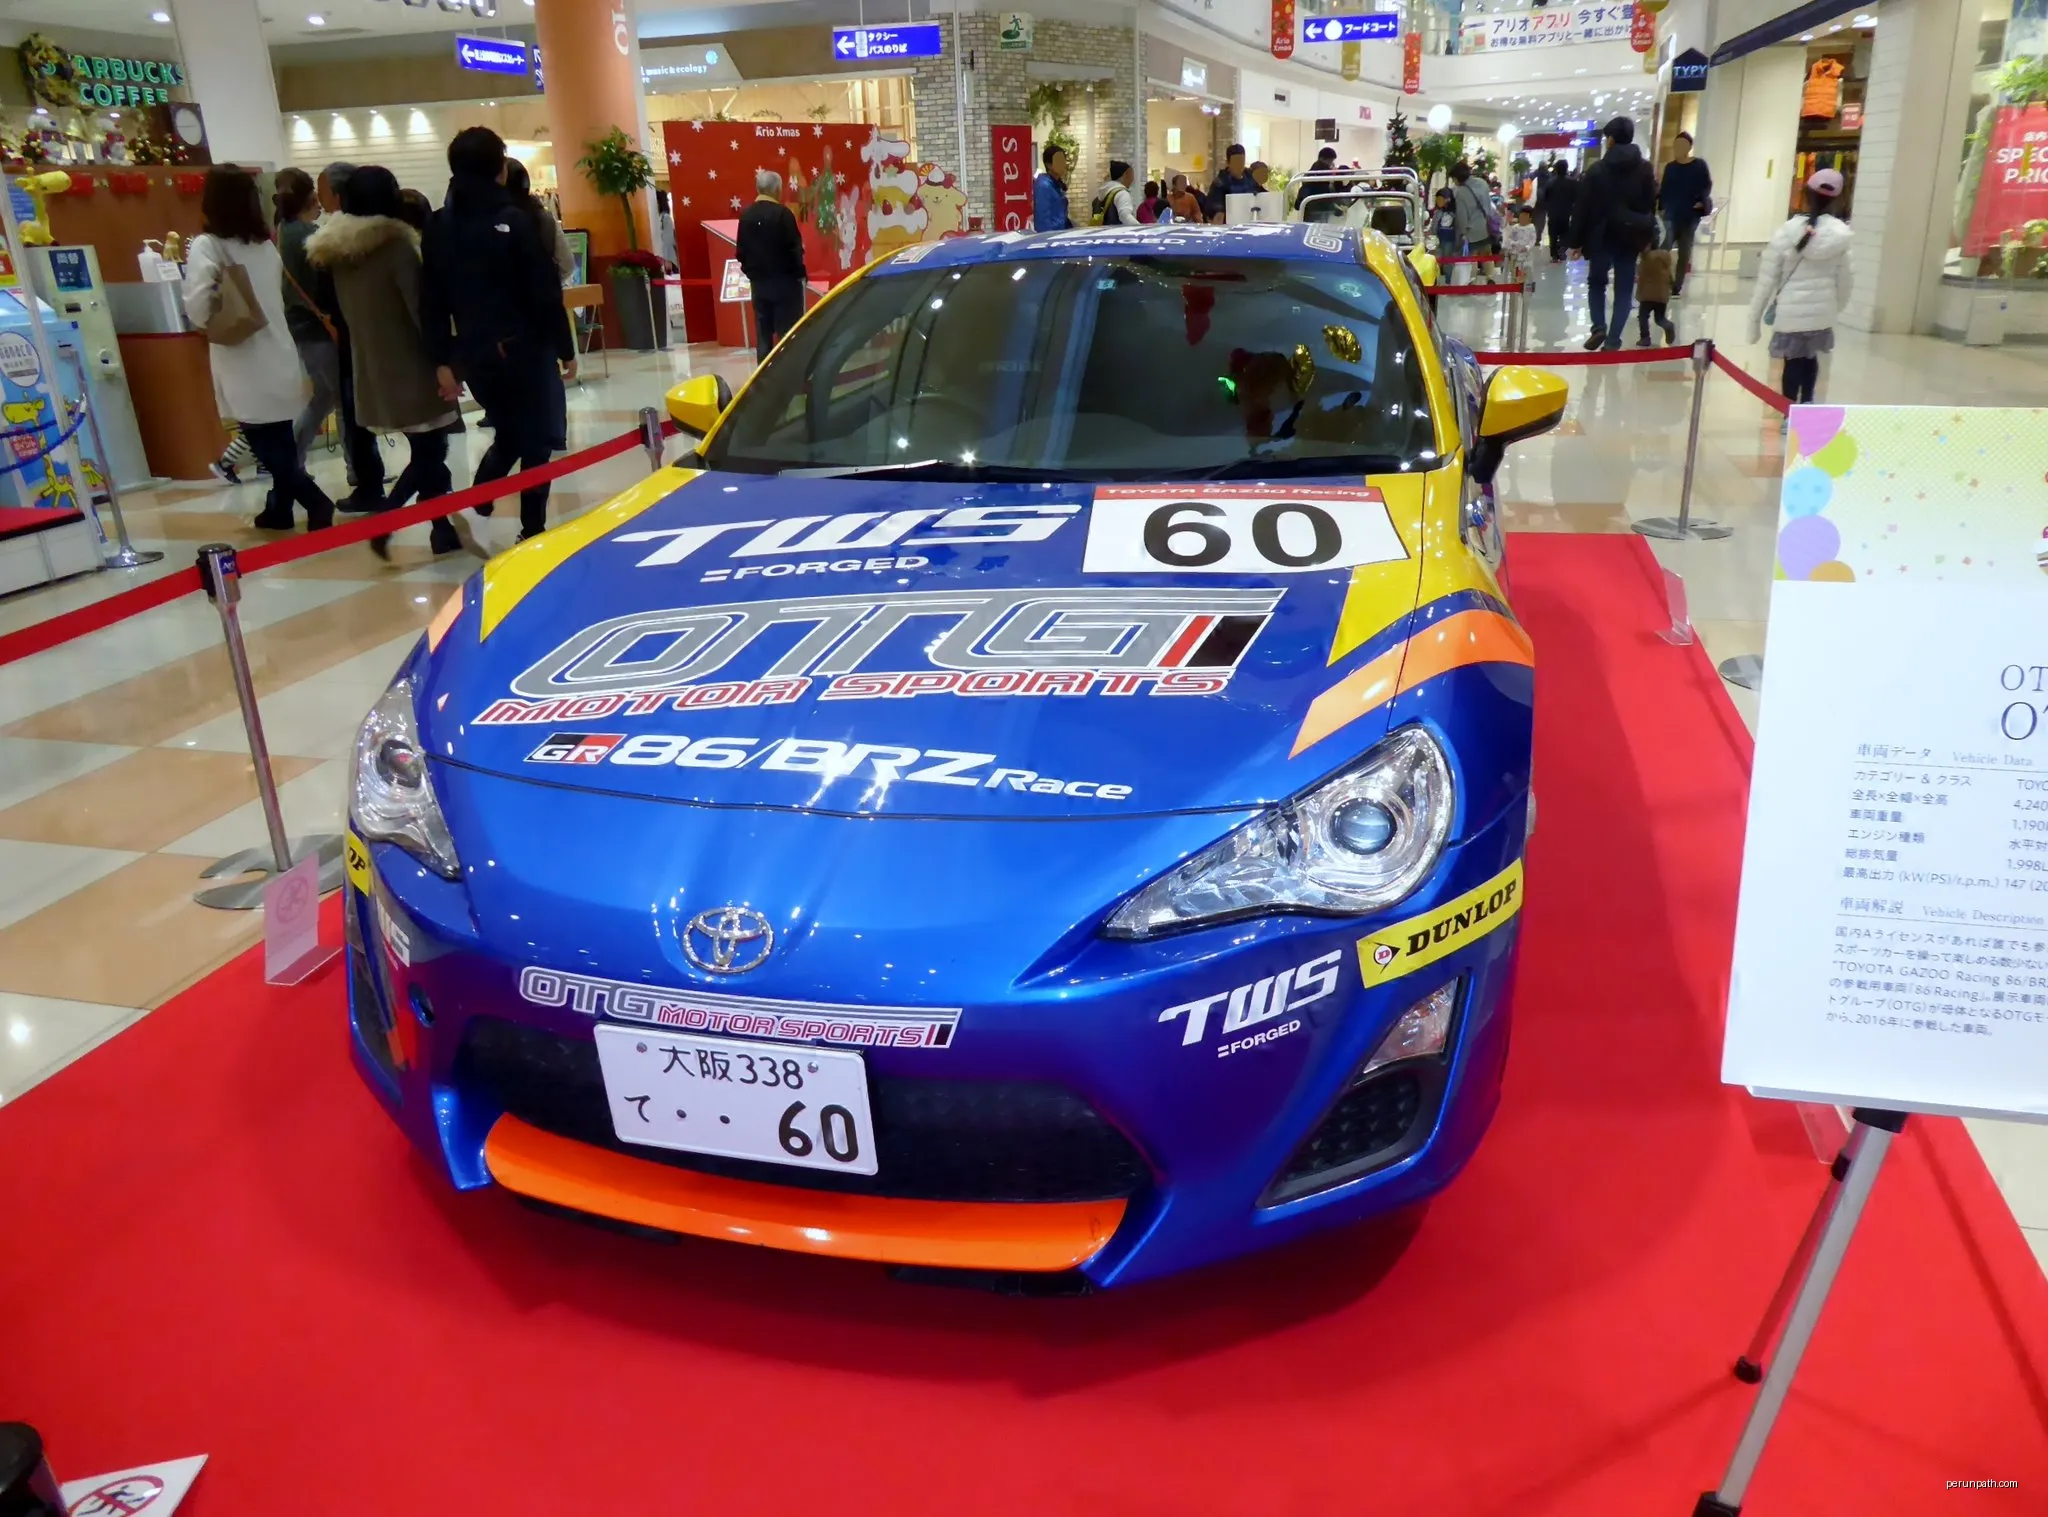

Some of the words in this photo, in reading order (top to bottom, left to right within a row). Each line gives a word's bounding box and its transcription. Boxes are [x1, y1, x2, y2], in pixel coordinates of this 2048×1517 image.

[868, 32, 898, 41] タクシー
[1344, 22, 1396, 34] フードコート
[869, 43, 908, 55] バスのりば
[1673, 65, 1708, 77] TYPY
[755, 126, 775, 138] Ario
[776, 126, 800, 138] Xmas
[1002, 136, 1028, 231] sale
[1291, 489, 1370, 497] Racing
[611, 504, 1083, 567] TWS
[1143, 502, 1343, 567] 60
[734, 556, 930, 580] FORGED
[471, 676, 813, 726] MOTOR
[818, 667, 1234, 700] SPORTS
[1856, 744, 1931, 759] 車両データ
[1952, 751, 1998, 765] Vehicle
[2003, 754, 2033, 767] Data
[983, 768, 1133, 800] Race
[1920, 773, 1931, 785] &
[1406, 879, 1518, 957] DUNLOP
[1922, 905, 1967, 920] Vehicle
[1899, 966, 1950, 981] GAZOO
[1955, 969, 2001, 987] Racing
[1158, 949, 1342, 1047] TWS
[657, 1003, 776, 1035] MOTOR
[778, 1018, 927, 1047] SPORTS
[1230, 1019, 1301, 1055] FORGED
